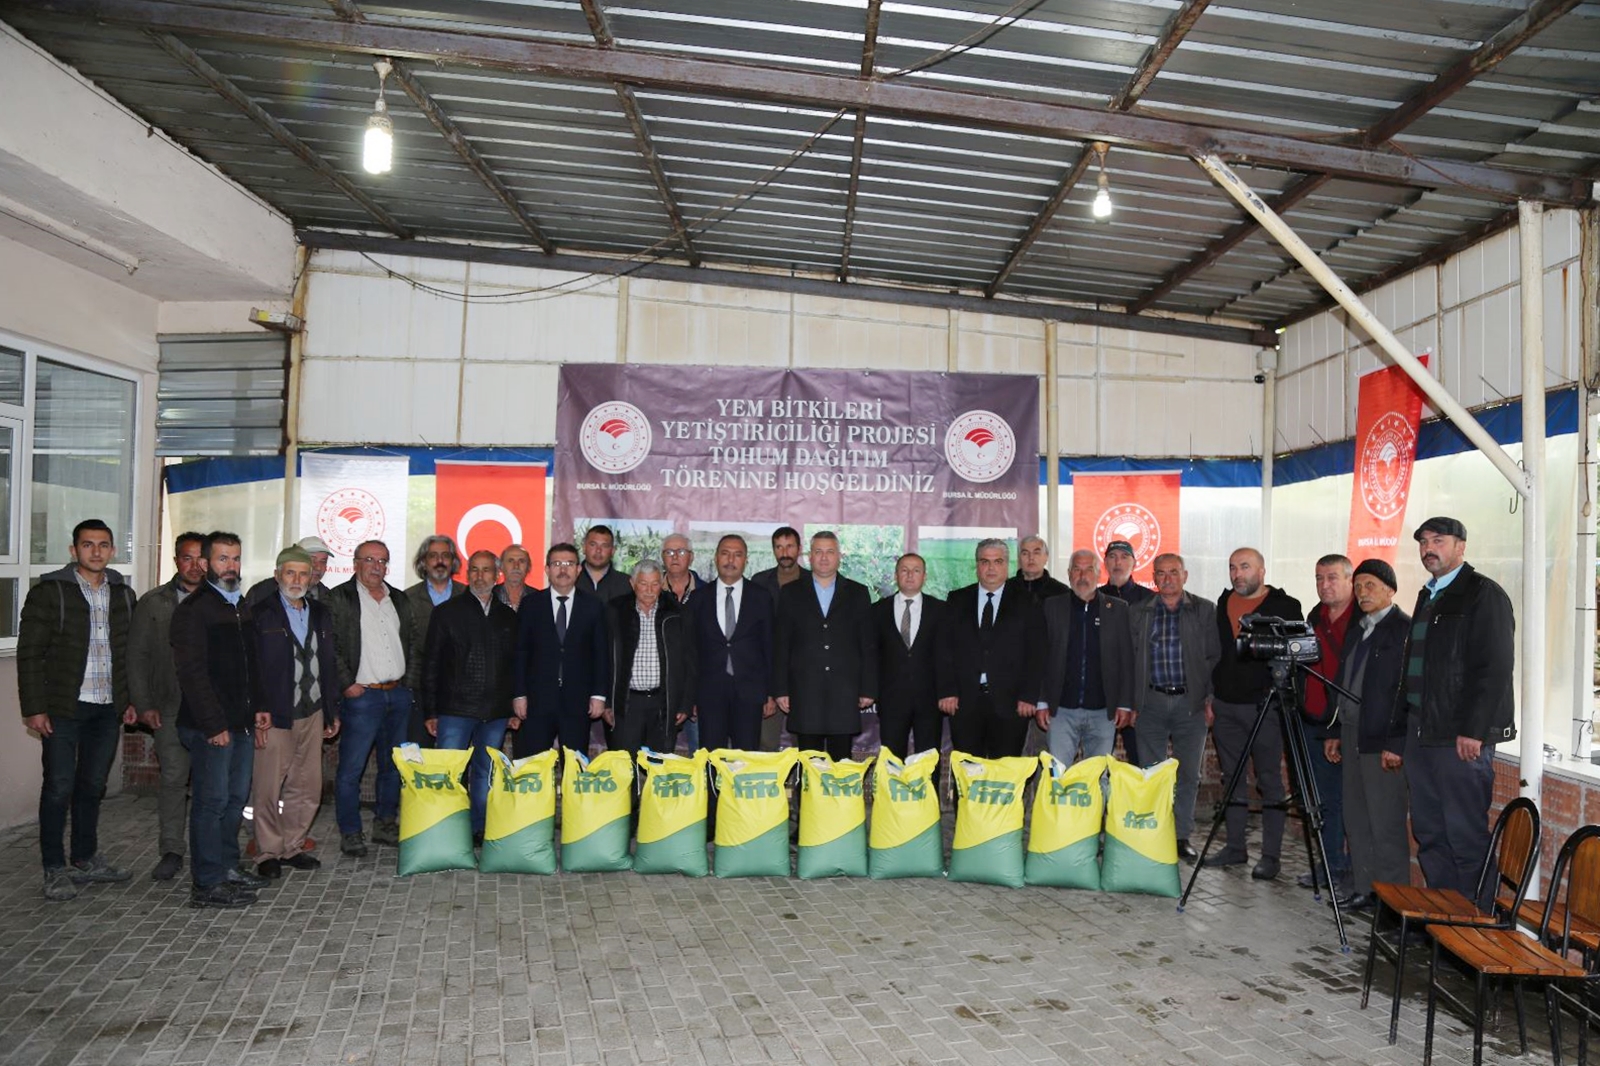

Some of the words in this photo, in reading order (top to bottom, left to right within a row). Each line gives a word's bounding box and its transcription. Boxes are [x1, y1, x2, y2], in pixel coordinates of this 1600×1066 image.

[717, 398, 763, 417] YEM
[771, 395, 882, 420] BİTKİLERİ
[661, 418, 840, 444] YETİŞTİRİCİLİĞİ
[847, 423, 936, 445] PROJESİ
[709, 446, 788, 466] TOHUM
[795, 443, 888, 468] DAĞITIM
[577, 482, 600, 490] BURSA
[660, 464, 777, 489] TÖRENİNE
[784, 470, 935, 495] HOŞGELDİNİZ
[942, 491, 966, 499] BURSA
